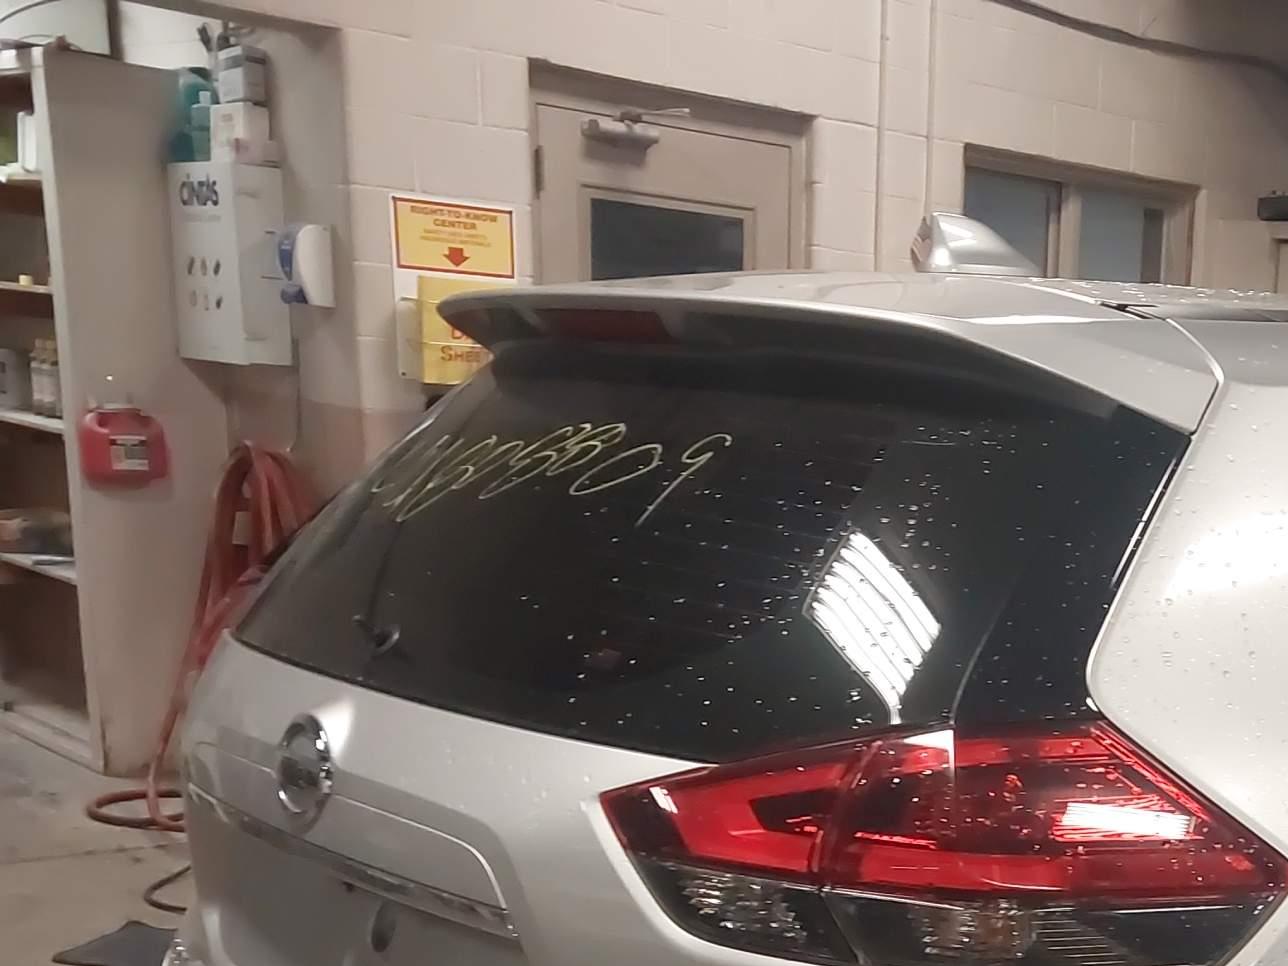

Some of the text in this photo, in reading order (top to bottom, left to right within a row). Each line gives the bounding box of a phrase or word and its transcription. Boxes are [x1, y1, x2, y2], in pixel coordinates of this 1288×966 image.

[410, 205, 498, 223] RIGHT-TO-KNOW
[433, 218, 477, 230] CENTER
[440, 345, 481, 363] SHEE
